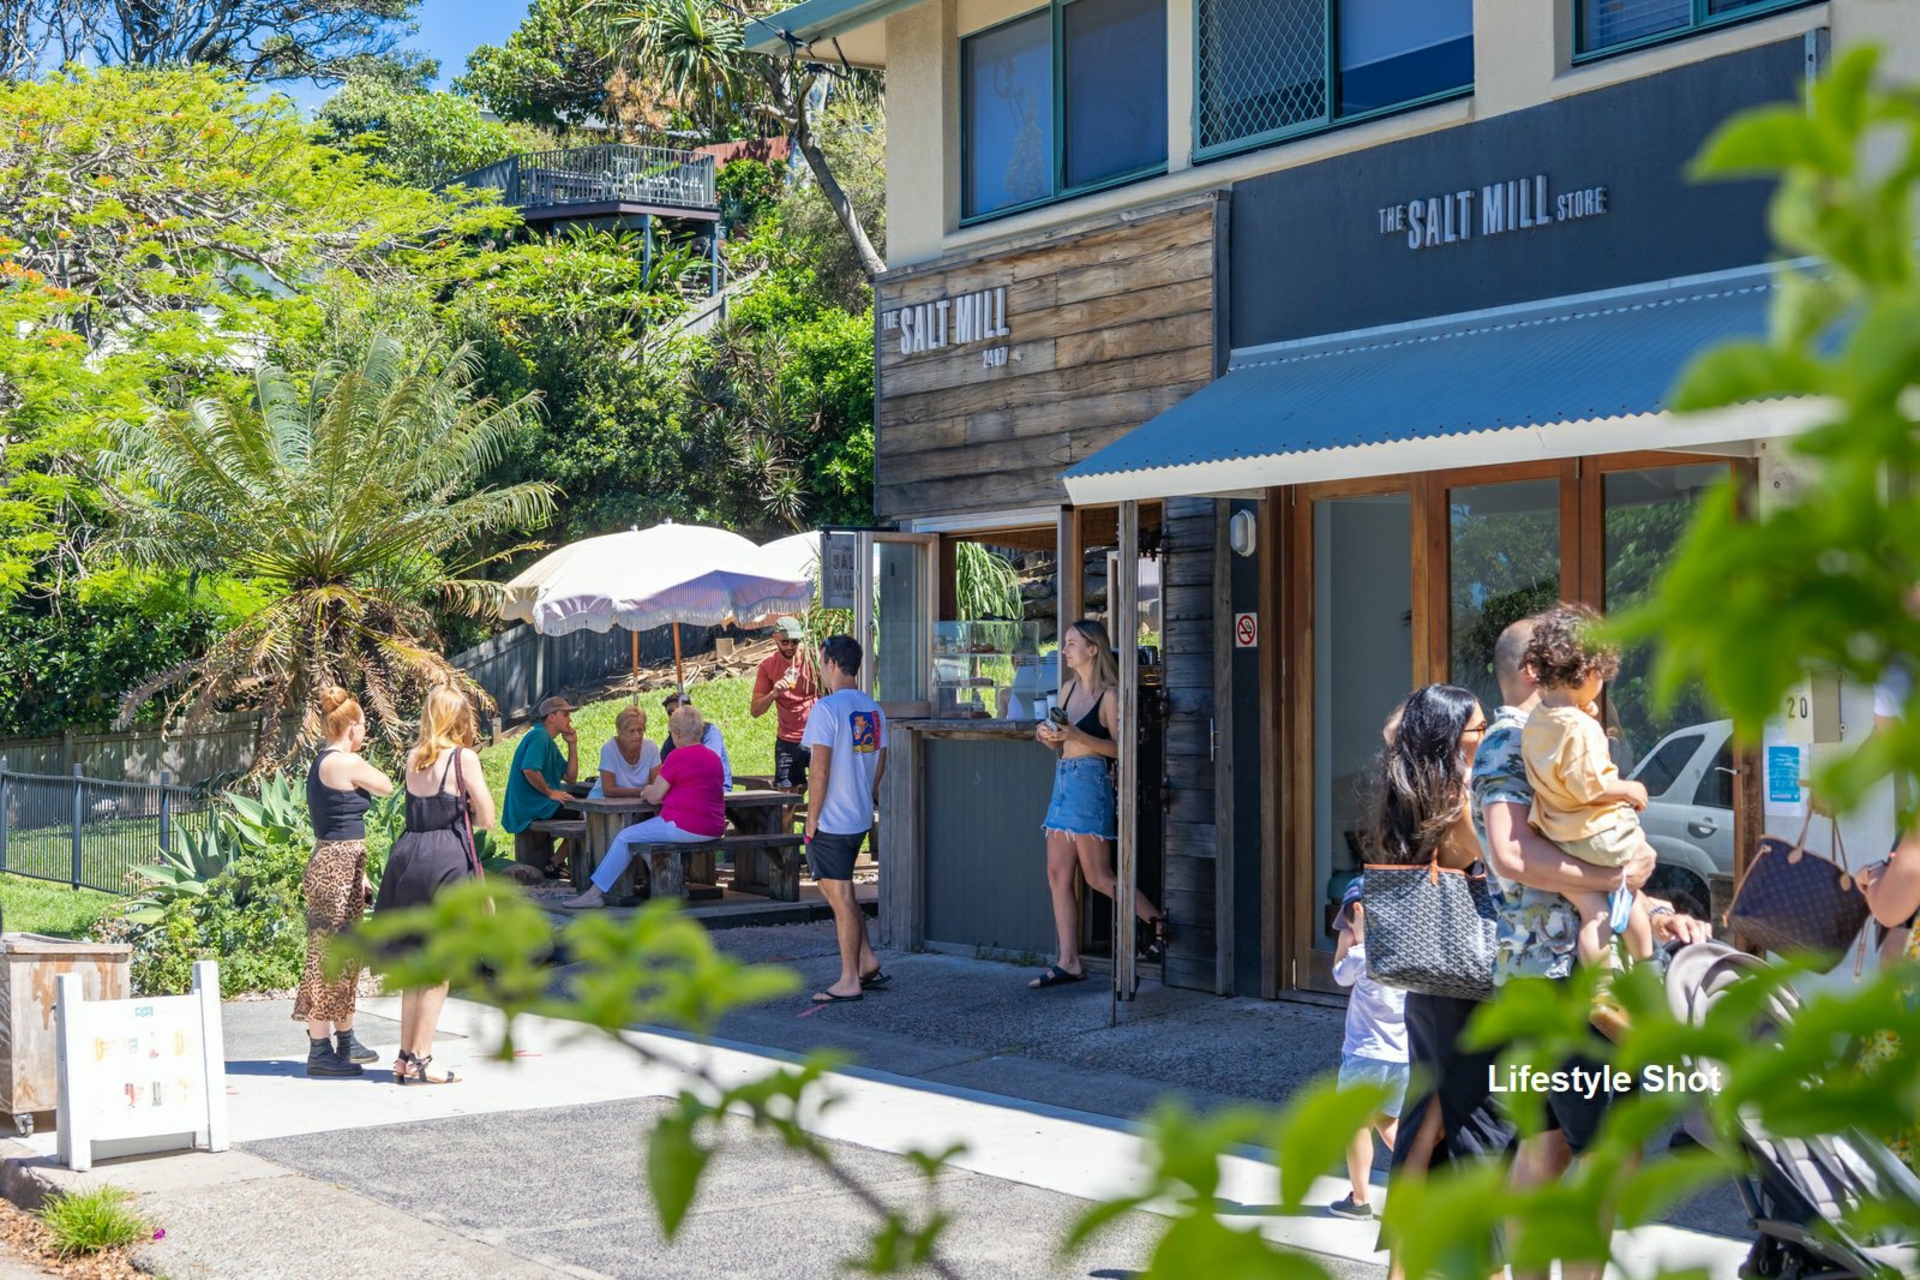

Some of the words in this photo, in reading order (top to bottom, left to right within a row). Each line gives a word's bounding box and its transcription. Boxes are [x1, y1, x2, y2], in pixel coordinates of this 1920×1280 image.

[1379, 205, 1407, 234] THE
[1408, 190, 1475, 250] SALT
[1483, 175, 1553, 235] MILL
[1557, 187, 1608, 222] STORE
[882, 311, 899, 329] THE
[901, 300, 949, 355] SALT
[956, 288, 1009, 344] MILL
[983, 347, 1008, 368] 2487
[833, 554, 854, 570] SAL
[833, 575, 854, 591] MIL
